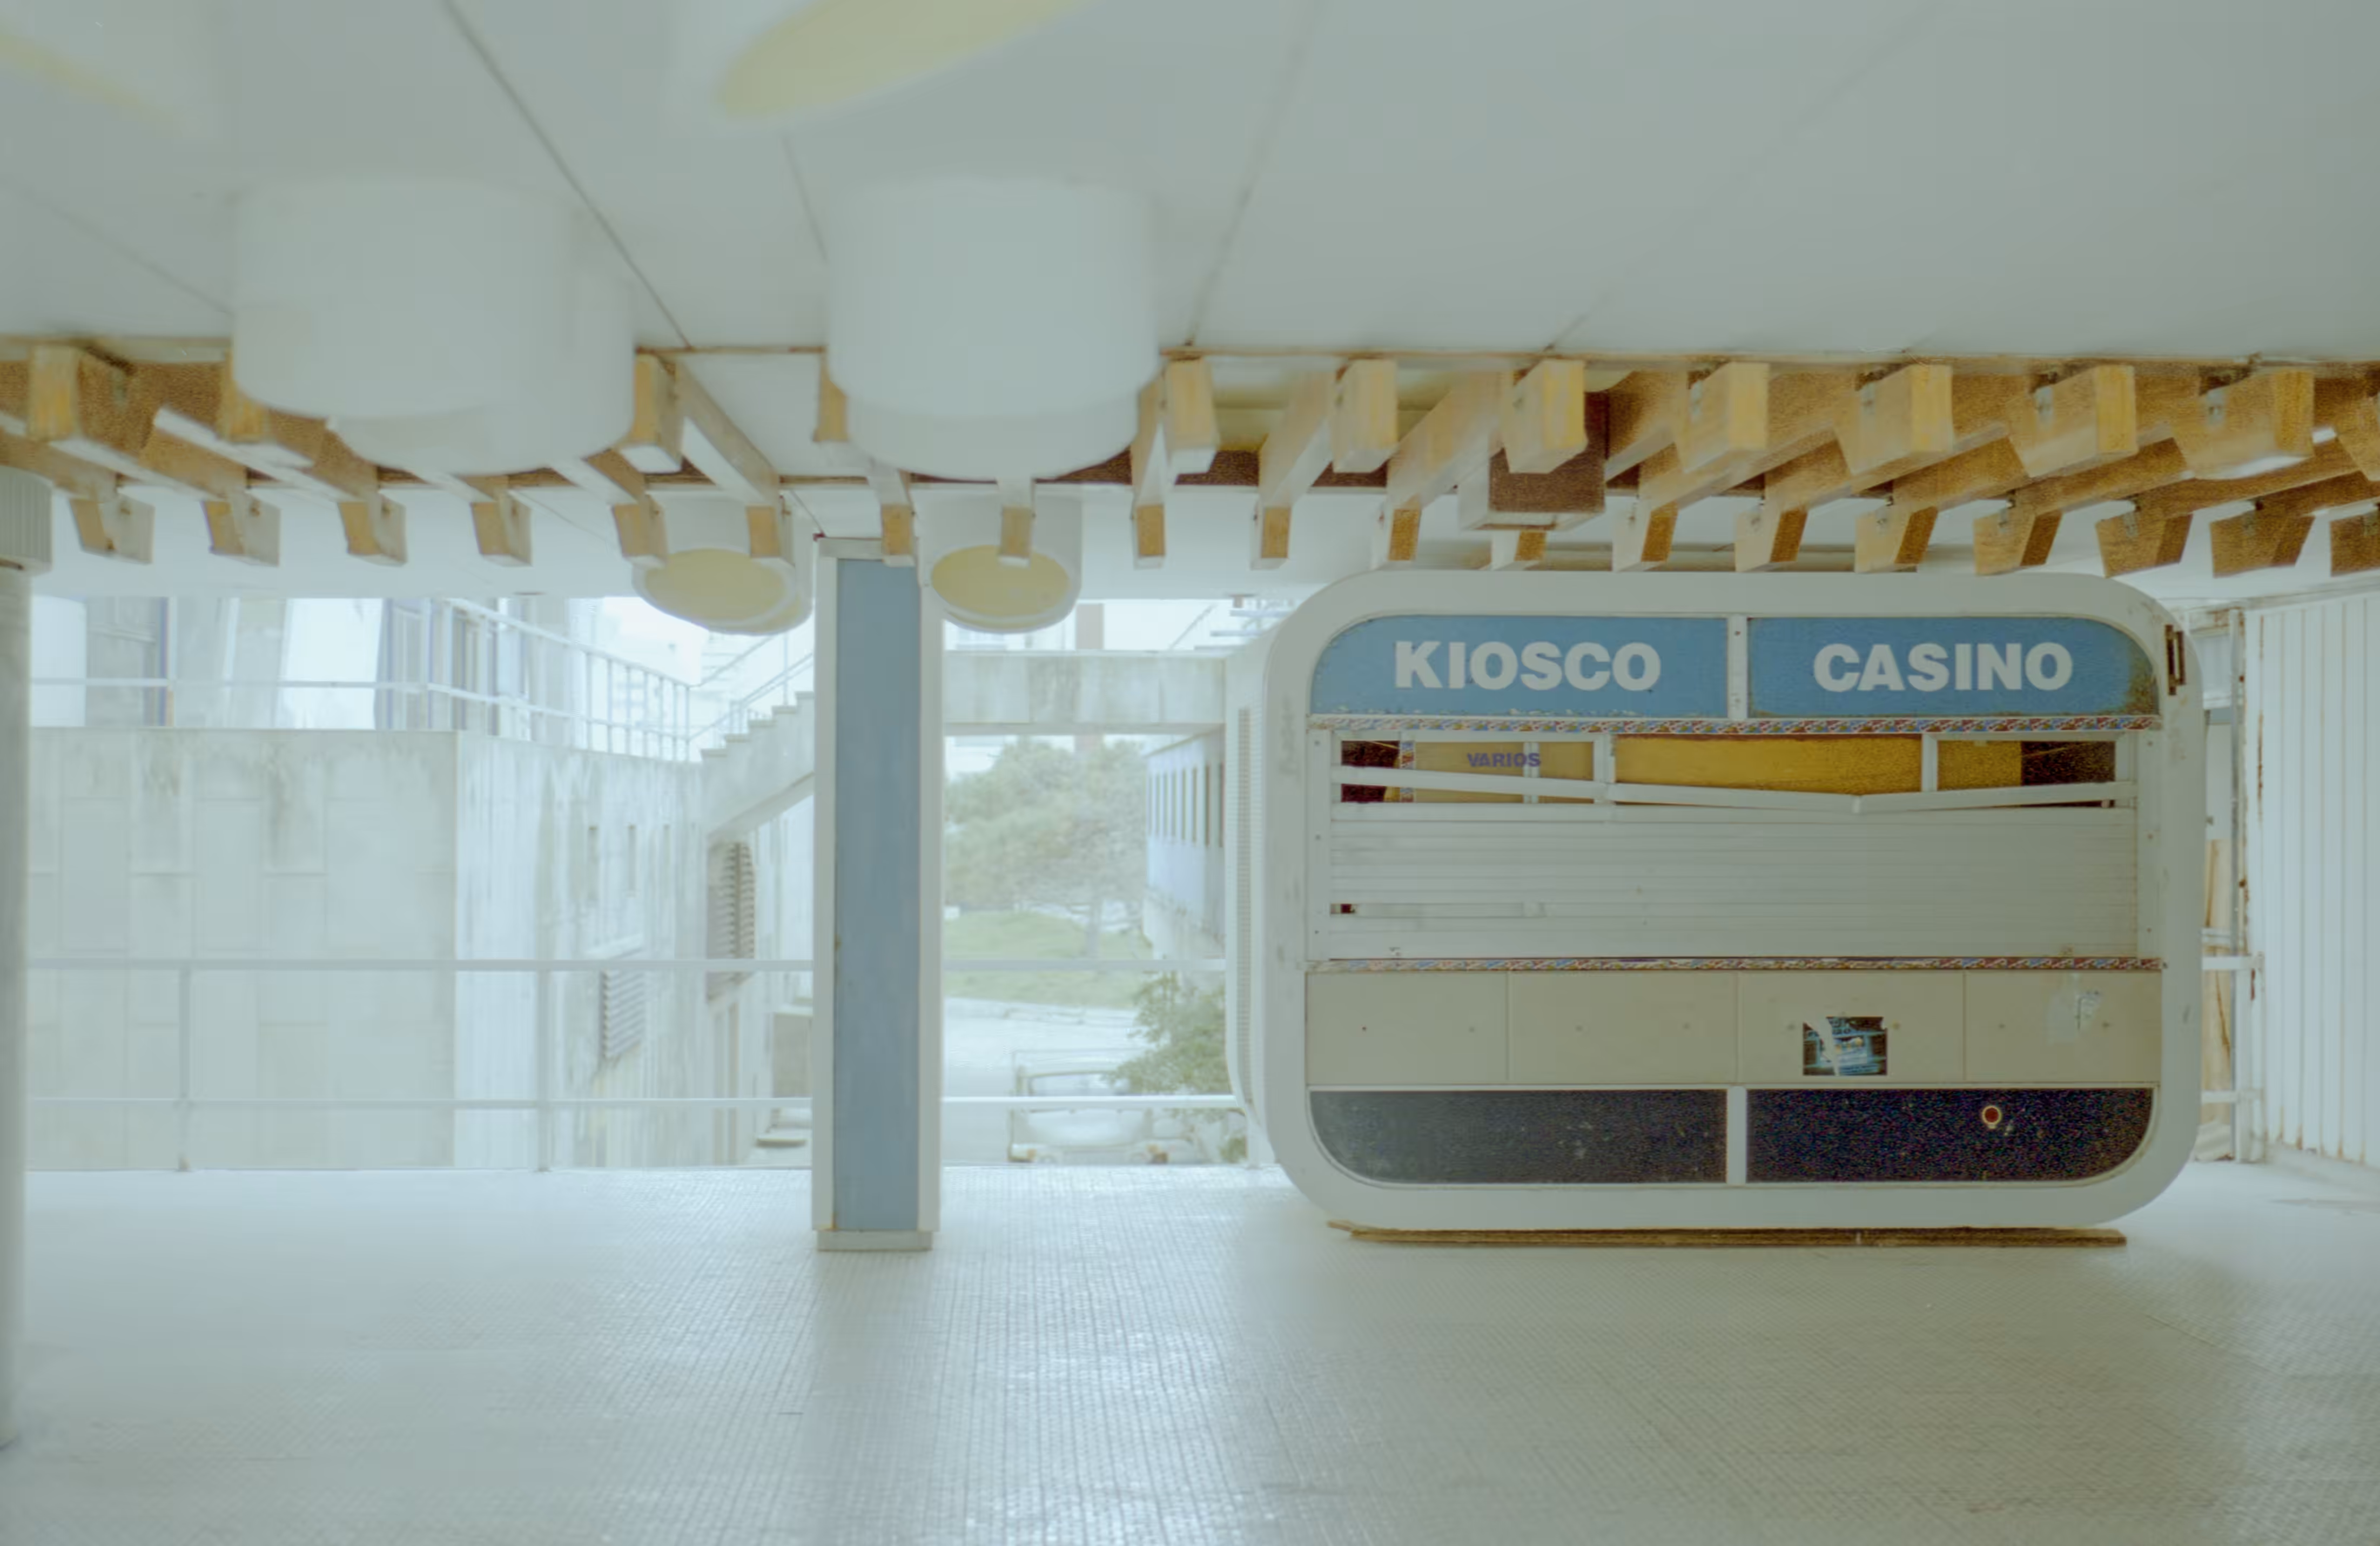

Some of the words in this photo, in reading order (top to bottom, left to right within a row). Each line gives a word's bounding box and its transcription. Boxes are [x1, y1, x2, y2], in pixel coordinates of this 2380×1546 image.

[1395, 641, 1660, 691] KIOSCO
[1814, 642, 2073, 692] CASINO
[1467, 752, 1541, 767] VARIOS
